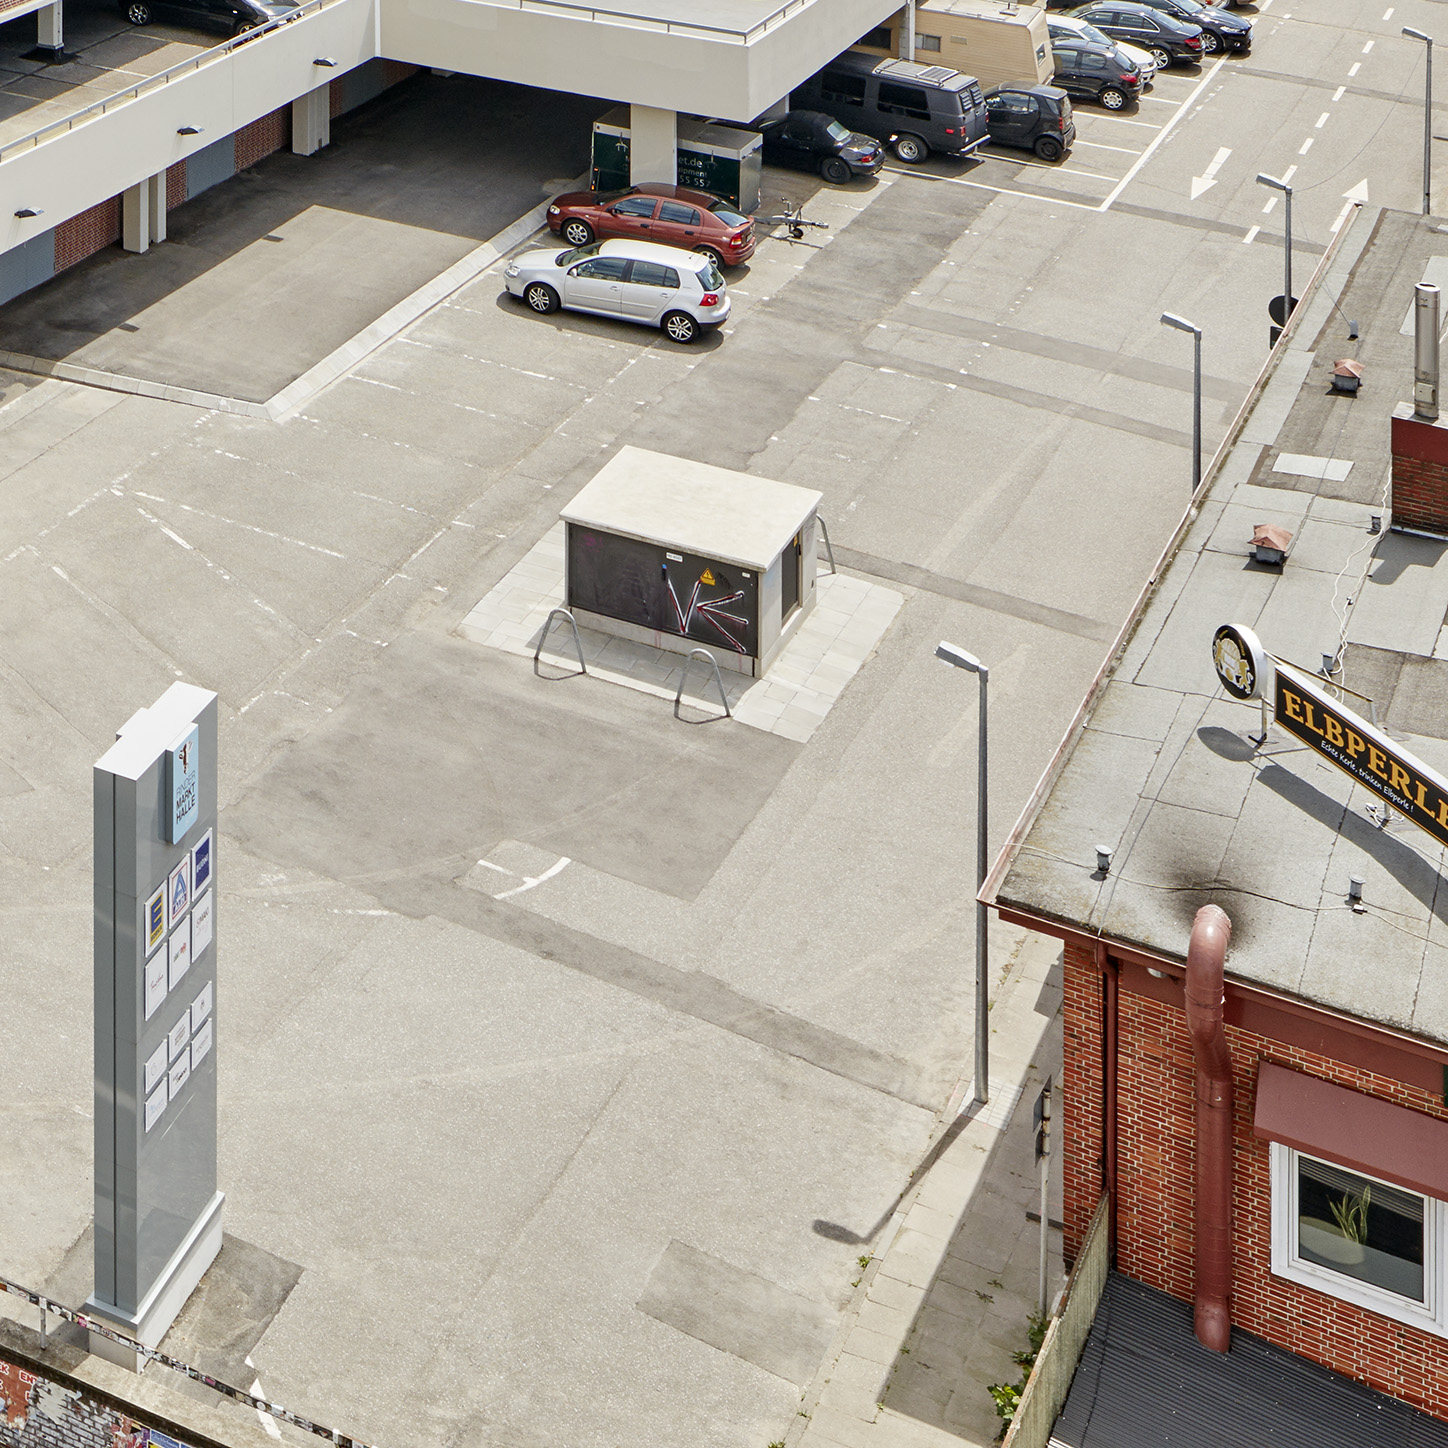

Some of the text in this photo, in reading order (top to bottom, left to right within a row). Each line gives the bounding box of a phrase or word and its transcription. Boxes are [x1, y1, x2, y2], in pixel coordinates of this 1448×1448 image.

[176, 770, 196, 795] RINDER
[1321, 740, 1339, 758] Echte
[1359, 767, 1382, 790] trinken
[1383, 786, 1409, 812] Elbperle
[176, 782, 196, 811] MARKT
[176, 794, 196, 824] HALLE
